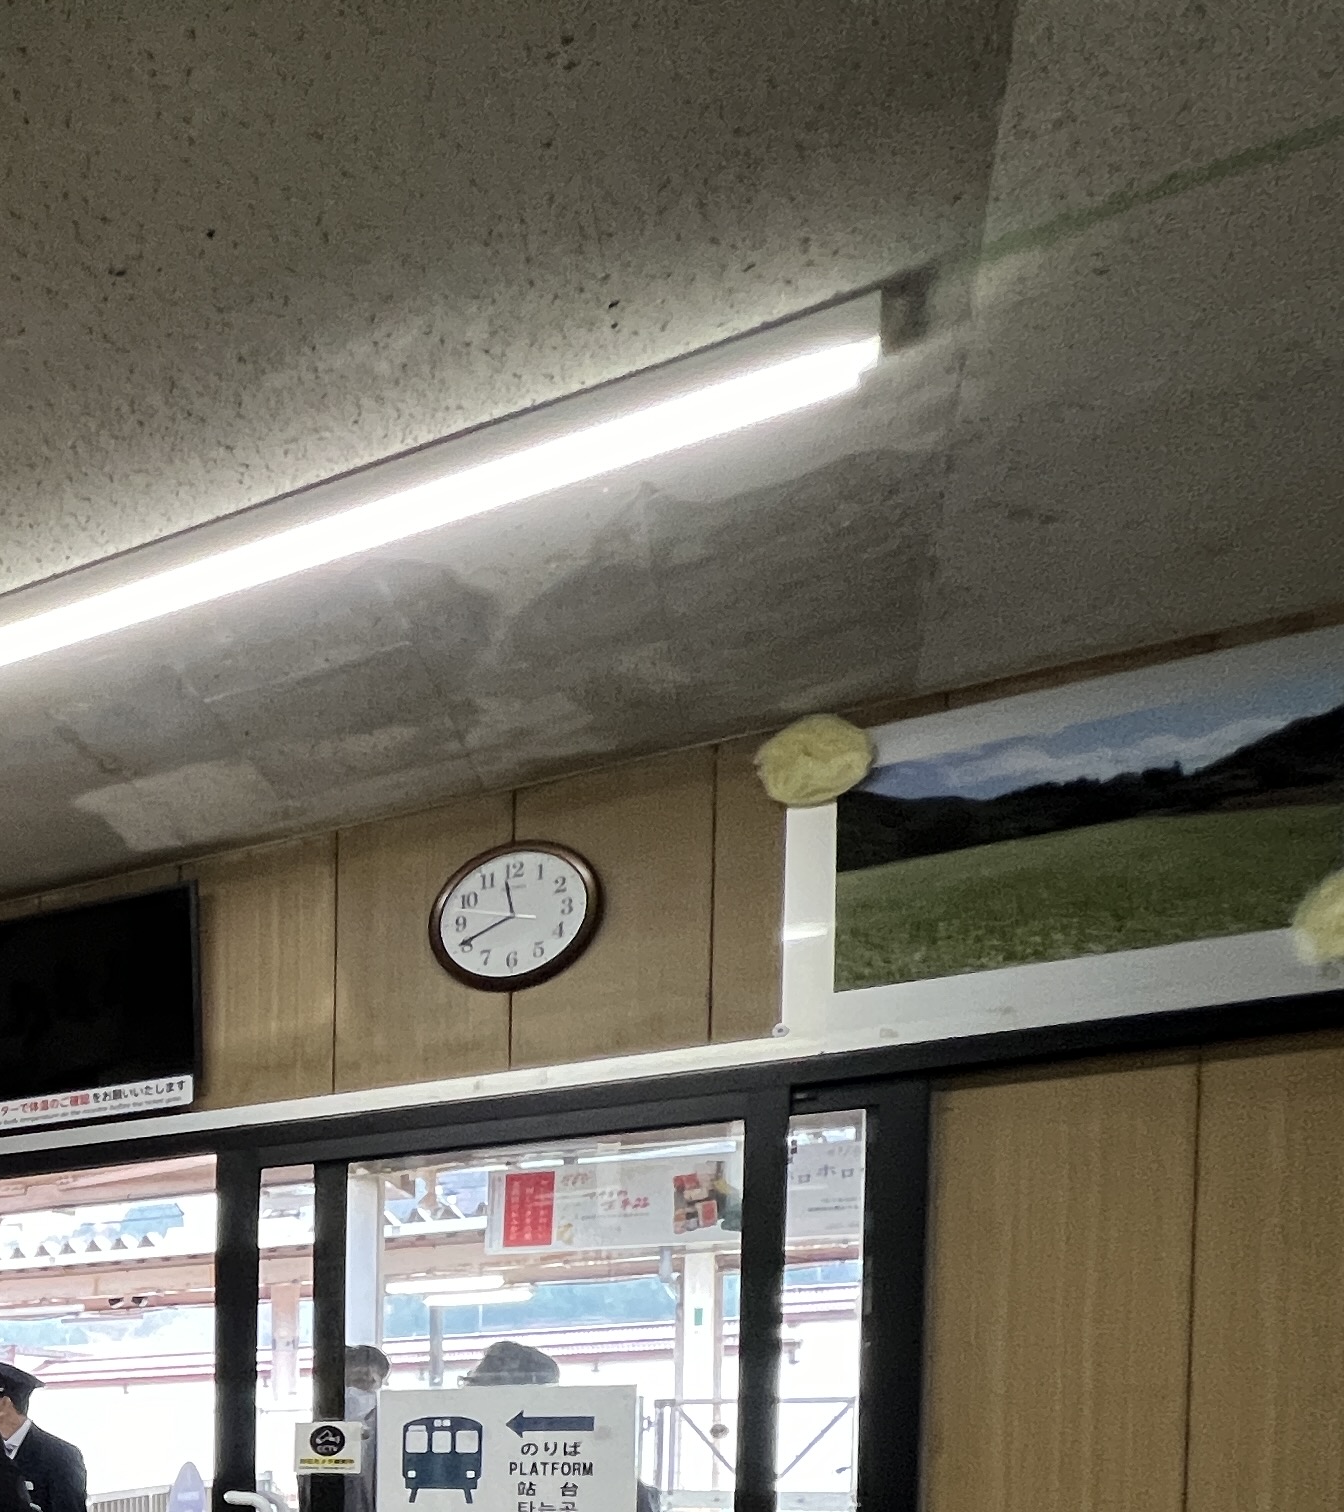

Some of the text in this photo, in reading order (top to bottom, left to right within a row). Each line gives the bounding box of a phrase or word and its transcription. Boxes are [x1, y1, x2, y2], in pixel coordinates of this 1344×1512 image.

[506, 861, 524, 880] 12
[538, 864, 543, 880] 1
[480, 873, 494, 890] 11
[554, 876, 567, 894] 2
[461, 892, 478, 909] 10
[561, 898, 573, 915] 3
[455, 916, 466, 932] 9
[553, 921, 563, 938] 4
[480, 949, 492, 966] 7
[533, 941, 545, 958] 5
[506, 951, 517, 968] 6
[521, 1441, 582, 1456] のりば
[509, 1461, 593, 1476] PLATFORM
[560, 1482, 578, 1497] 台
